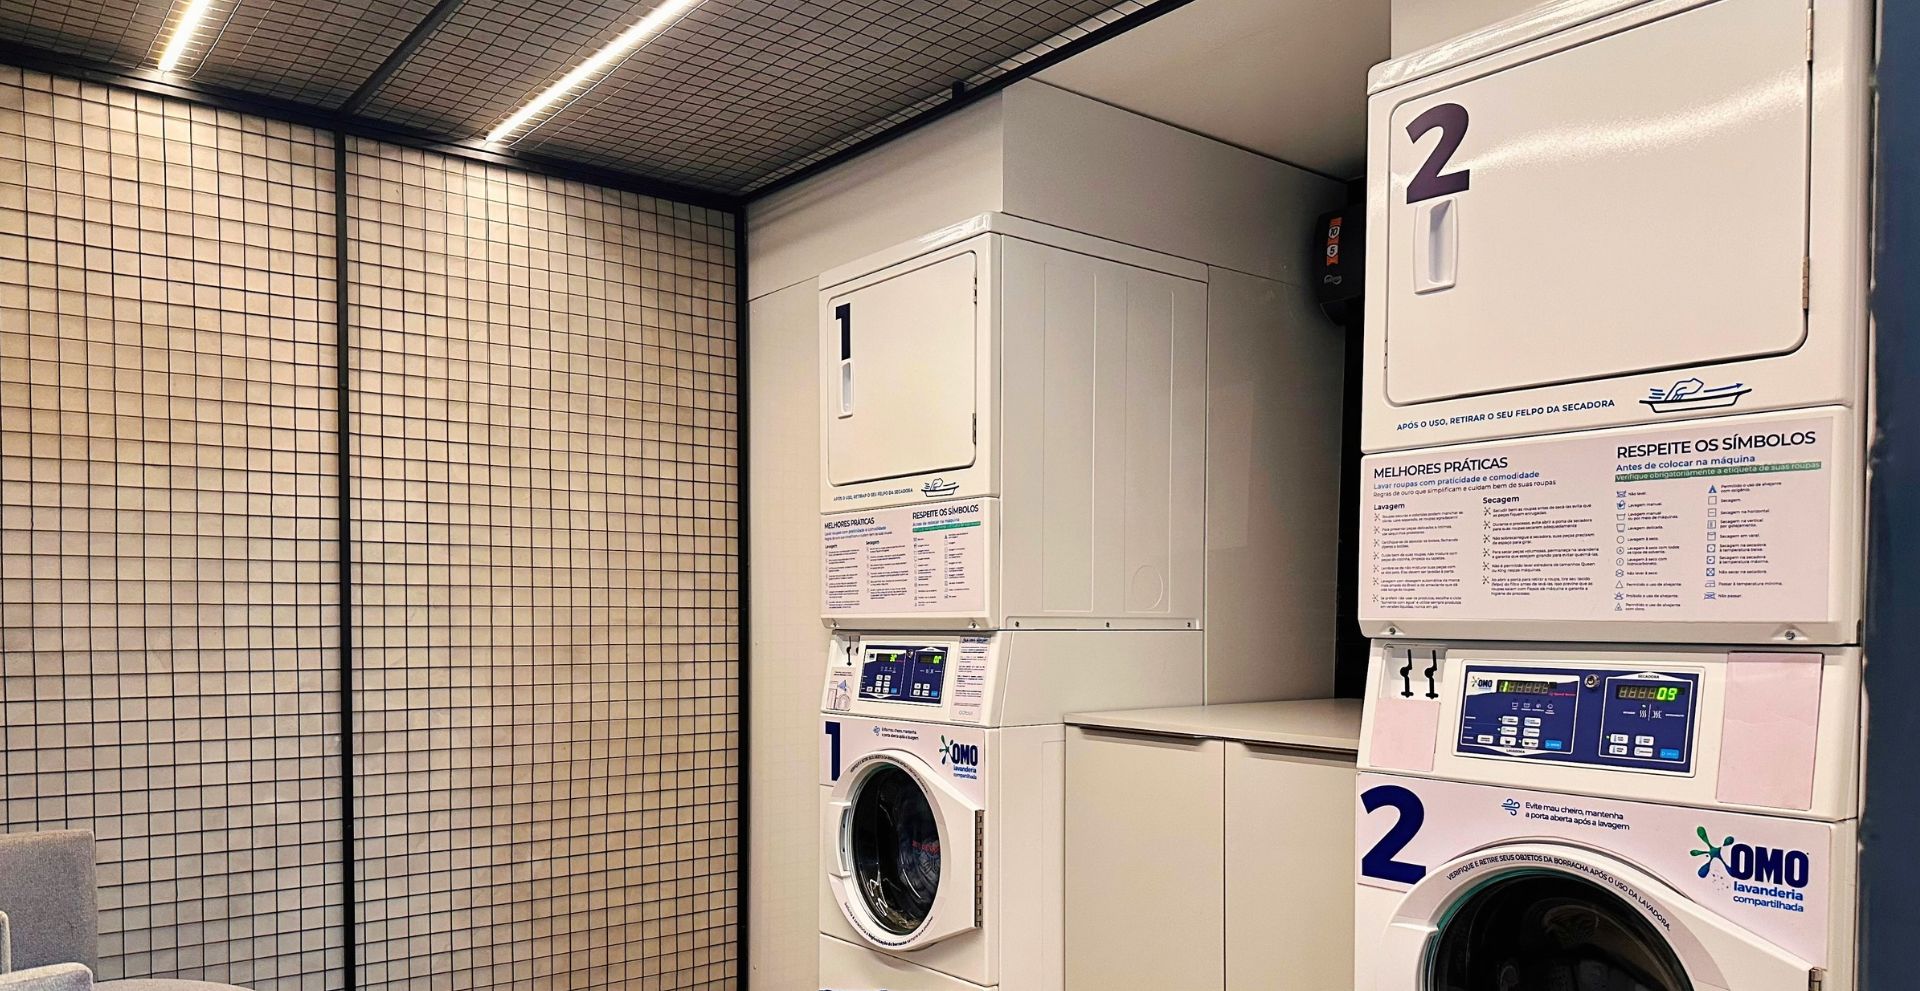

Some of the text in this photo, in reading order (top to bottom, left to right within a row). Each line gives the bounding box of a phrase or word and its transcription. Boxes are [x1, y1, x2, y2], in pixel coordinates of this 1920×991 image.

[1406, 103, 1470, 204] 2
[836, 303, 850, 361] 1
[1396, 420, 1418, 431] APÓS
[1428, 418, 1448, 428] USO,
[1449, 414, 1485, 425] RETIRAR
[1496, 411, 1513, 419] SEU
[1515, 407, 1544, 417] FELPO
[1546, 406, 1560, 414] DA
[1561, 400, 1615, 412] SECADORA
[1617, 428, 1815, 458] RESPEITE OS SÍMBOLOS
[1374, 455, 1507, 478] MELHORES PRÁTICAS
[1616, 463, 1642, 472] Antes
[1643, 462, 1656, 470] de
[1658, 459, 1693, 469] colocar
[1710, 455, 1755, 467] máquina
[1650, 469, 1714, 480] obrigatoriamente
[1724, 466, 1757, 475] etiqueta
[1791, 463, 1819, 471] roupas
[1373, 481, 1392, 489] Lavar
[1393, 481, 1418, 490] roupas
[1437, 475, 1480, 487] praticidade
[1488, 471, 1539, 481] comodidade
[1373, 491, 1392, 499] Regras
[1427, 486, 1461, 495] simplificam
[1482, 495, 1520, 505] Secagem
[912, 503, 978, 520] RESPEITE OS SÍMBOLOS
[1374, 503, 1405, 511] Lavagem
[824, 515, 874, 529] MELHORES PRÁTICAS
[1477, 680, 1493, 688] OMO
[826, 721, 840, 781] 1
[953, 743, 978, 766] OMO
[1525, 802, 1542, 810] Evite
[1560, 806, 1584, 816] cheiro,
[1585, 809, 1623, 819] mantenha
[1530, 812, 1548, 822] porta
[1550, 814, 1572, 823] aberta
[1573, 817, 1591, 827] após
[1598, 820, 1629, 831] lavagem
[1360, 785, 1426, 884] 2
[1731, 844, 1809, 888] OMO
[1447, 863, 1474, 880] VERIFIQUE
[1480, 856, 1499, 865] RETIRE
[1554, 859, 1589, 872] BORRACHA
[1590, 868, 1607, 880] APÓS
[1615, 881, 1628, 892] USO
[1628, 889, 1638, 900] DA
[1638, 896, 1670, 931] LAVADORA.
[1734, 881, 1803, 901] lavanderia
[1733, 895, 1803, 912] compartilhada
